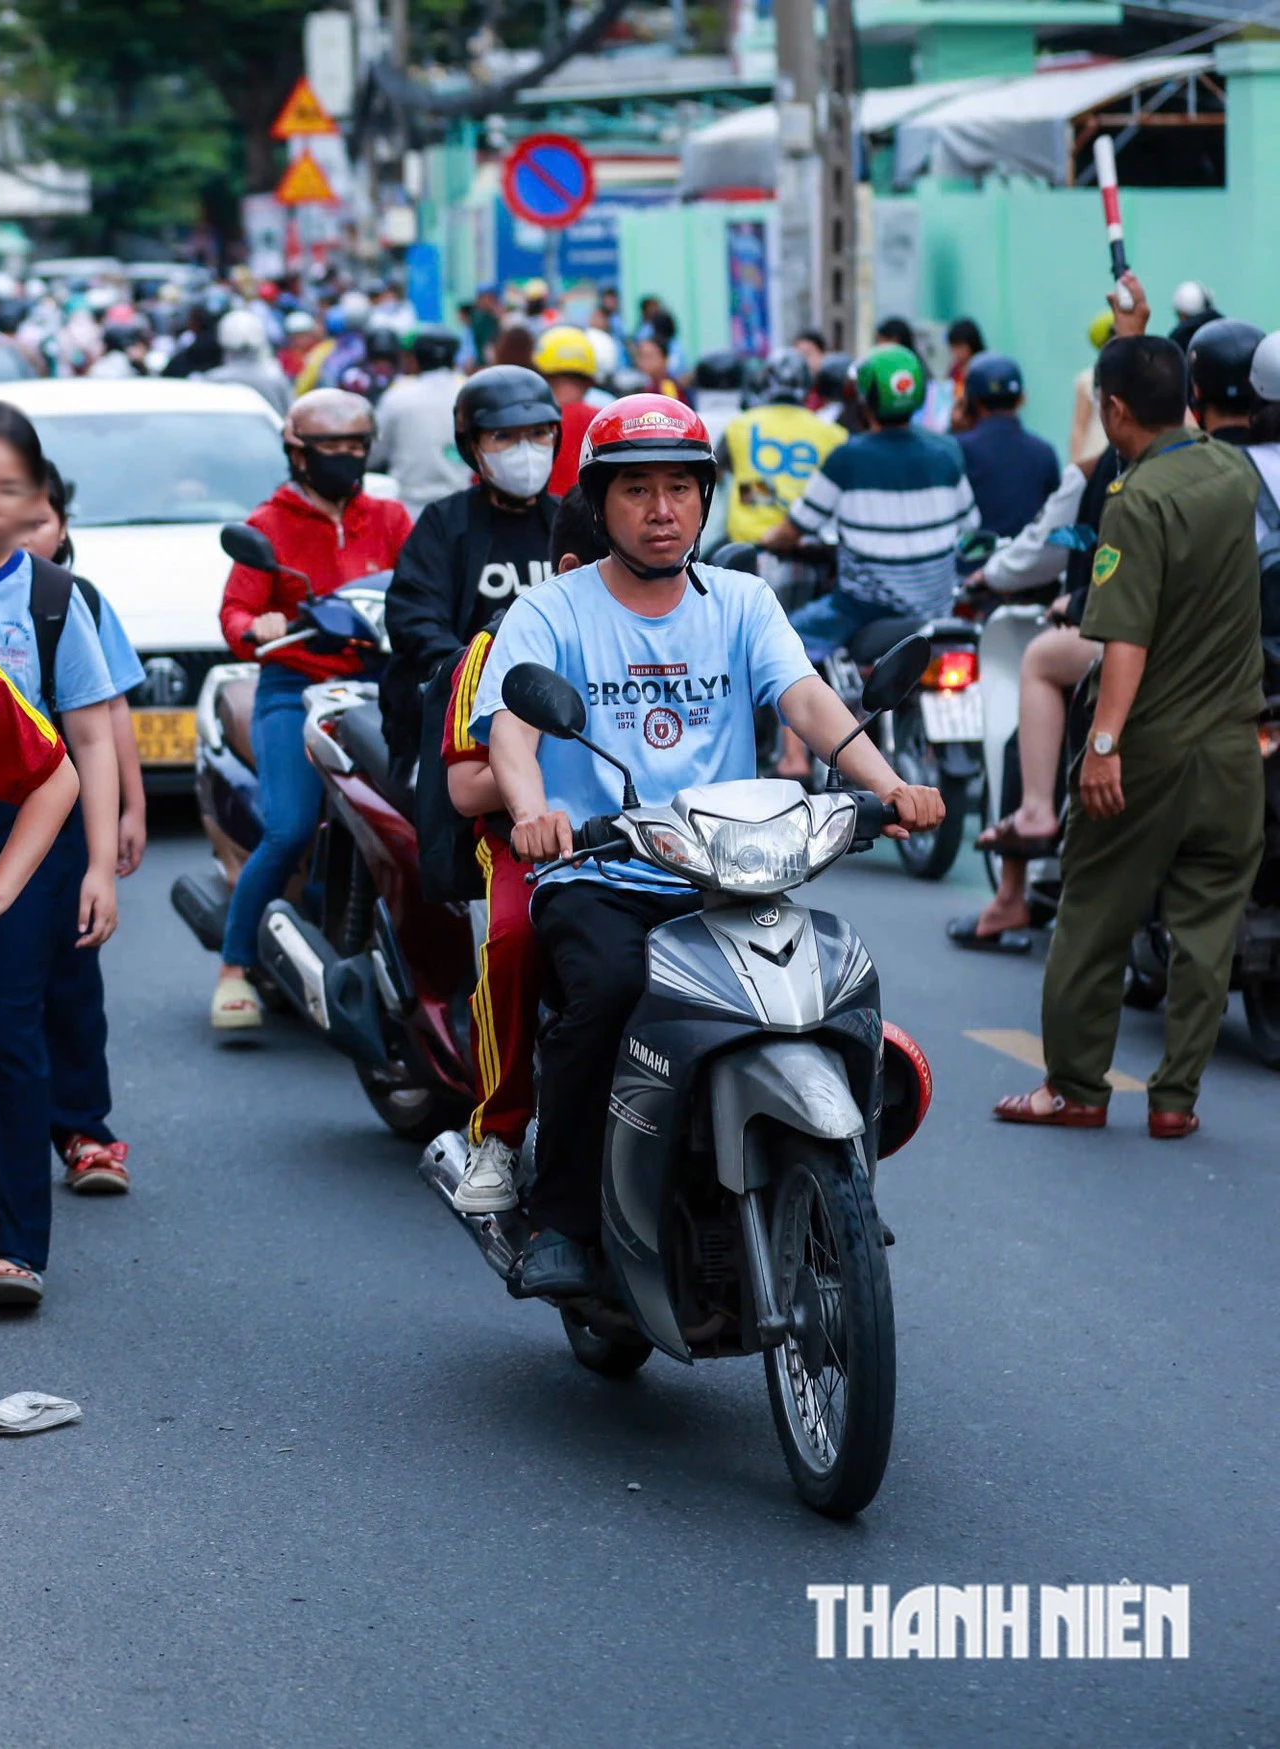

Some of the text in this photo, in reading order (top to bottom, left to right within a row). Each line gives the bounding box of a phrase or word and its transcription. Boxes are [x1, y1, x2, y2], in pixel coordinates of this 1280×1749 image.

[750, 424, 818, 479] be
[587, 674, 732, 706] BROOKLYN
[618, 721, 635, 729] 1974
[688, 717, 711, 726] DEPT.
[629, 1037, 670, 1077] YAMAHA
[611, 1101, 658, 1131] 4-STROKE
